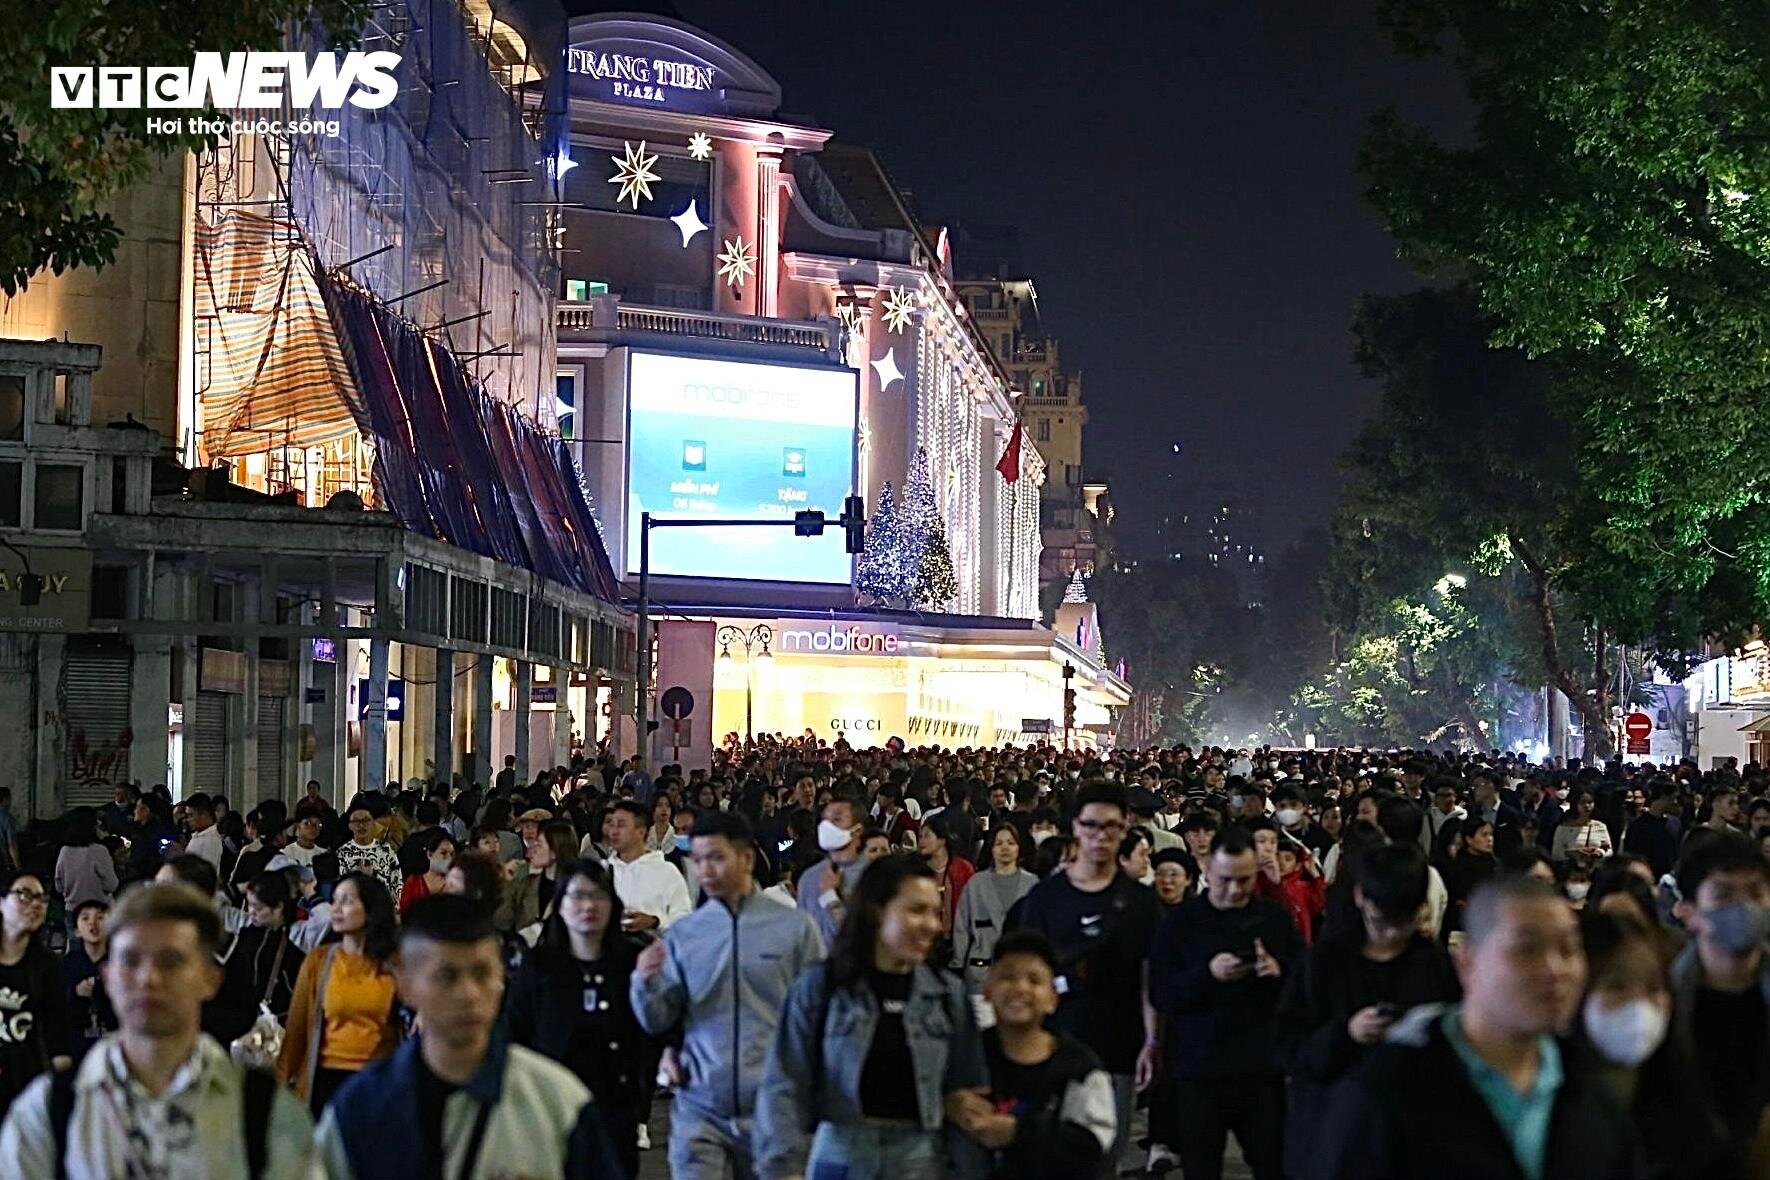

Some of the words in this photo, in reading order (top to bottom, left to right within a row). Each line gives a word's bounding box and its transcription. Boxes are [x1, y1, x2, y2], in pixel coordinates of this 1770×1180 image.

[564, 49, 650, 82] TRANG
[653, 60, 716, 90] TIEN
[613, 81, 666, 101] PLAZA
[19, 617, 65, 629] CENTER
[782, 624, 899, 652] mobifone
[830, 718, 881, 731] GUCCI
